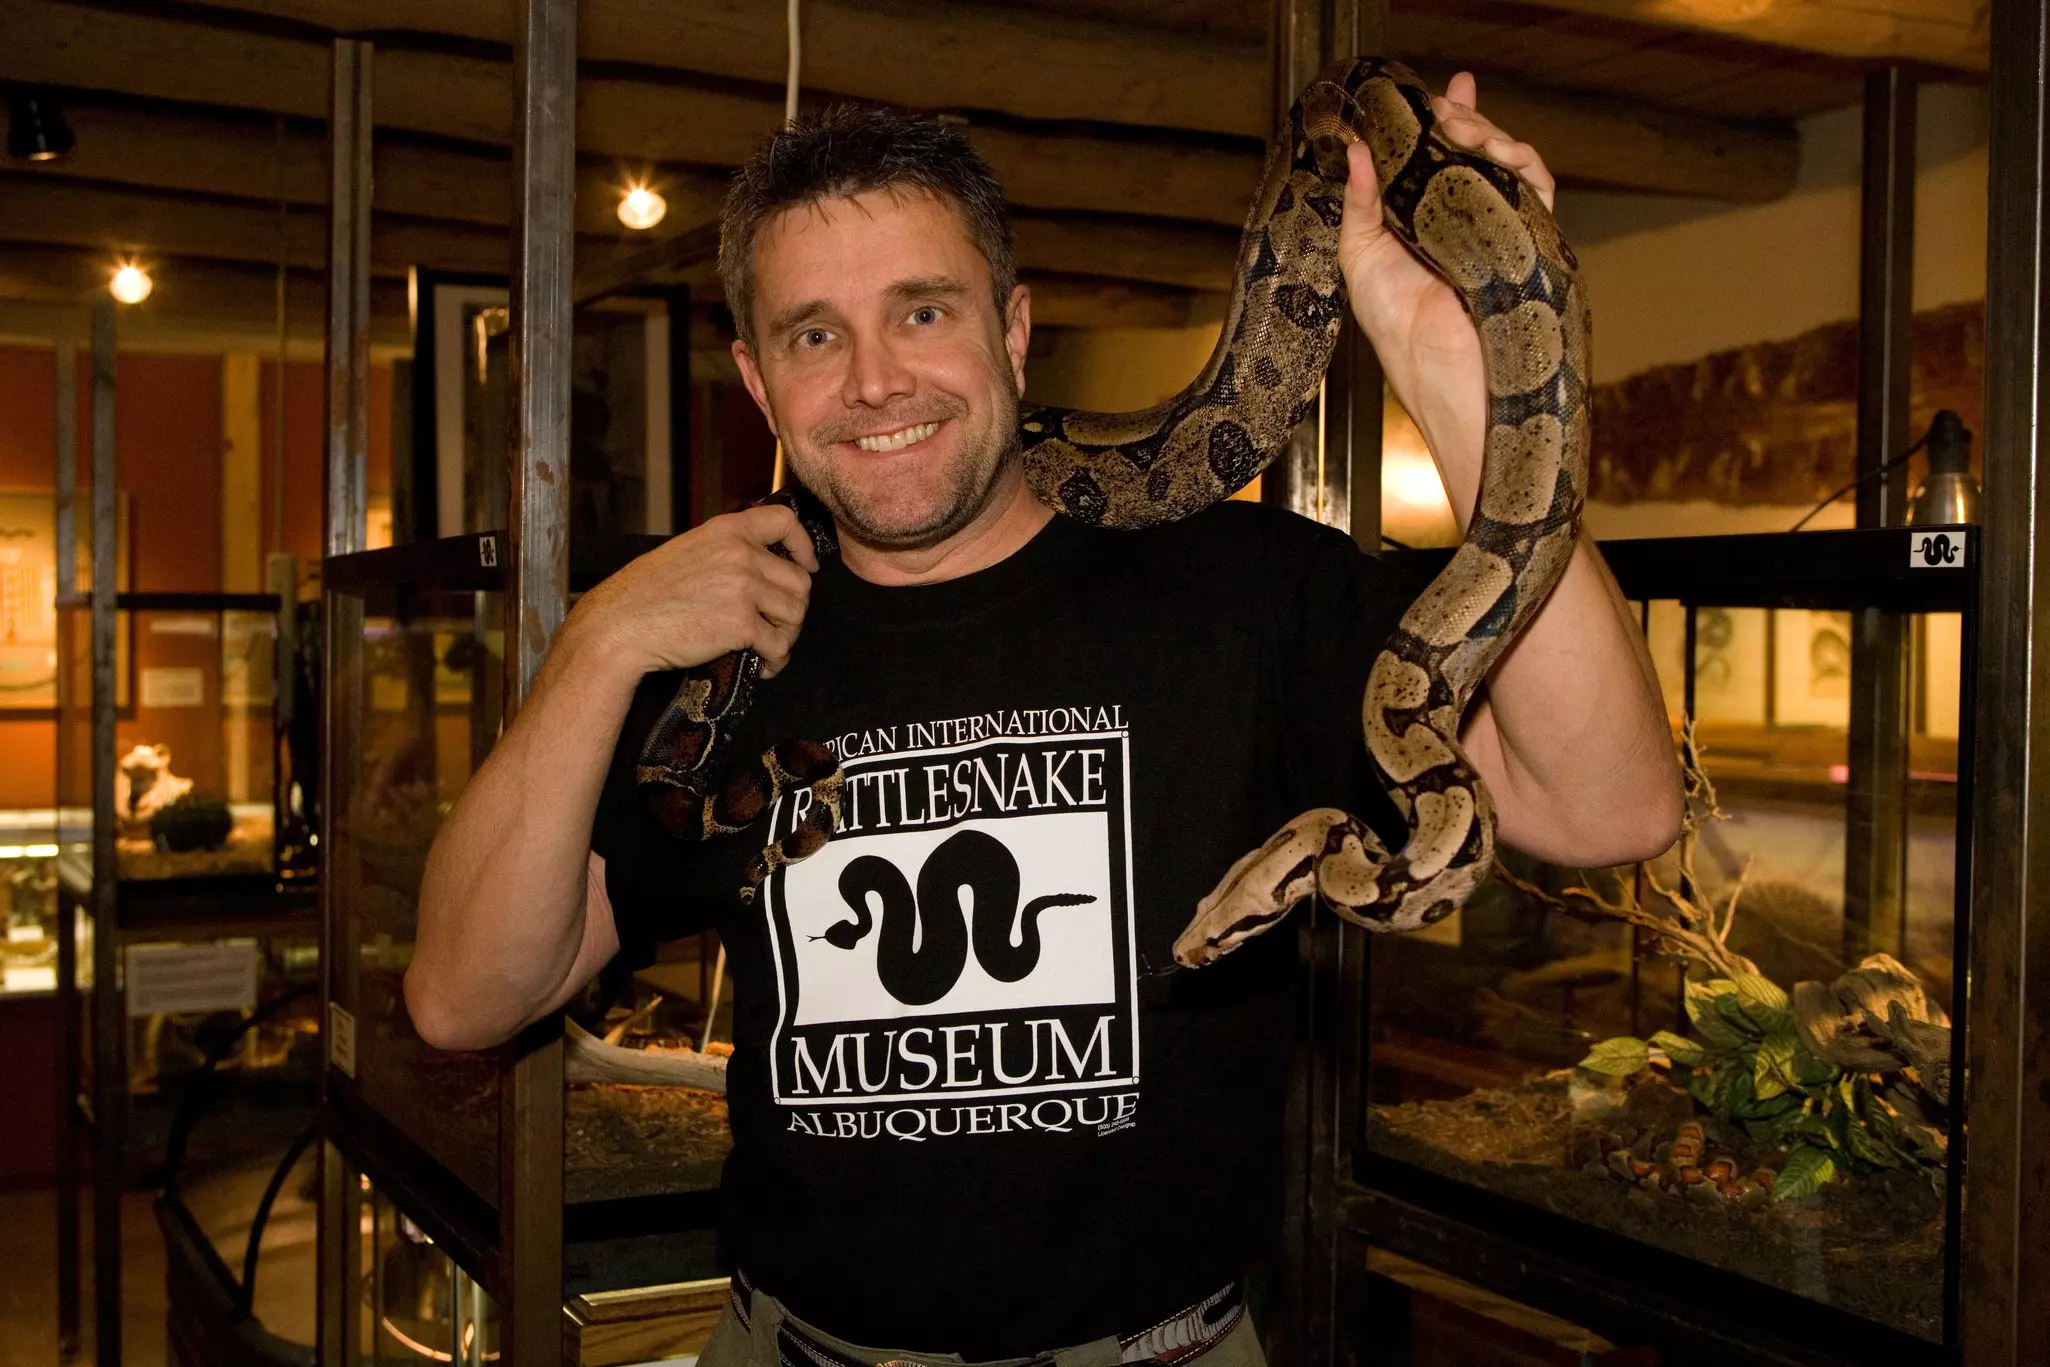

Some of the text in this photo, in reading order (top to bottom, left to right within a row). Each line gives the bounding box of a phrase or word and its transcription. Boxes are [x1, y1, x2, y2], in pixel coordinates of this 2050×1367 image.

[906, 704, 1129, 750] INTERNATIONAL
[792, 749, 1107, 834] RTTLESNAKE
[791, 1015, 1117, 1094] MUSEUM
[787, 1093, 1140, 1142] ALBUQUERQUE
